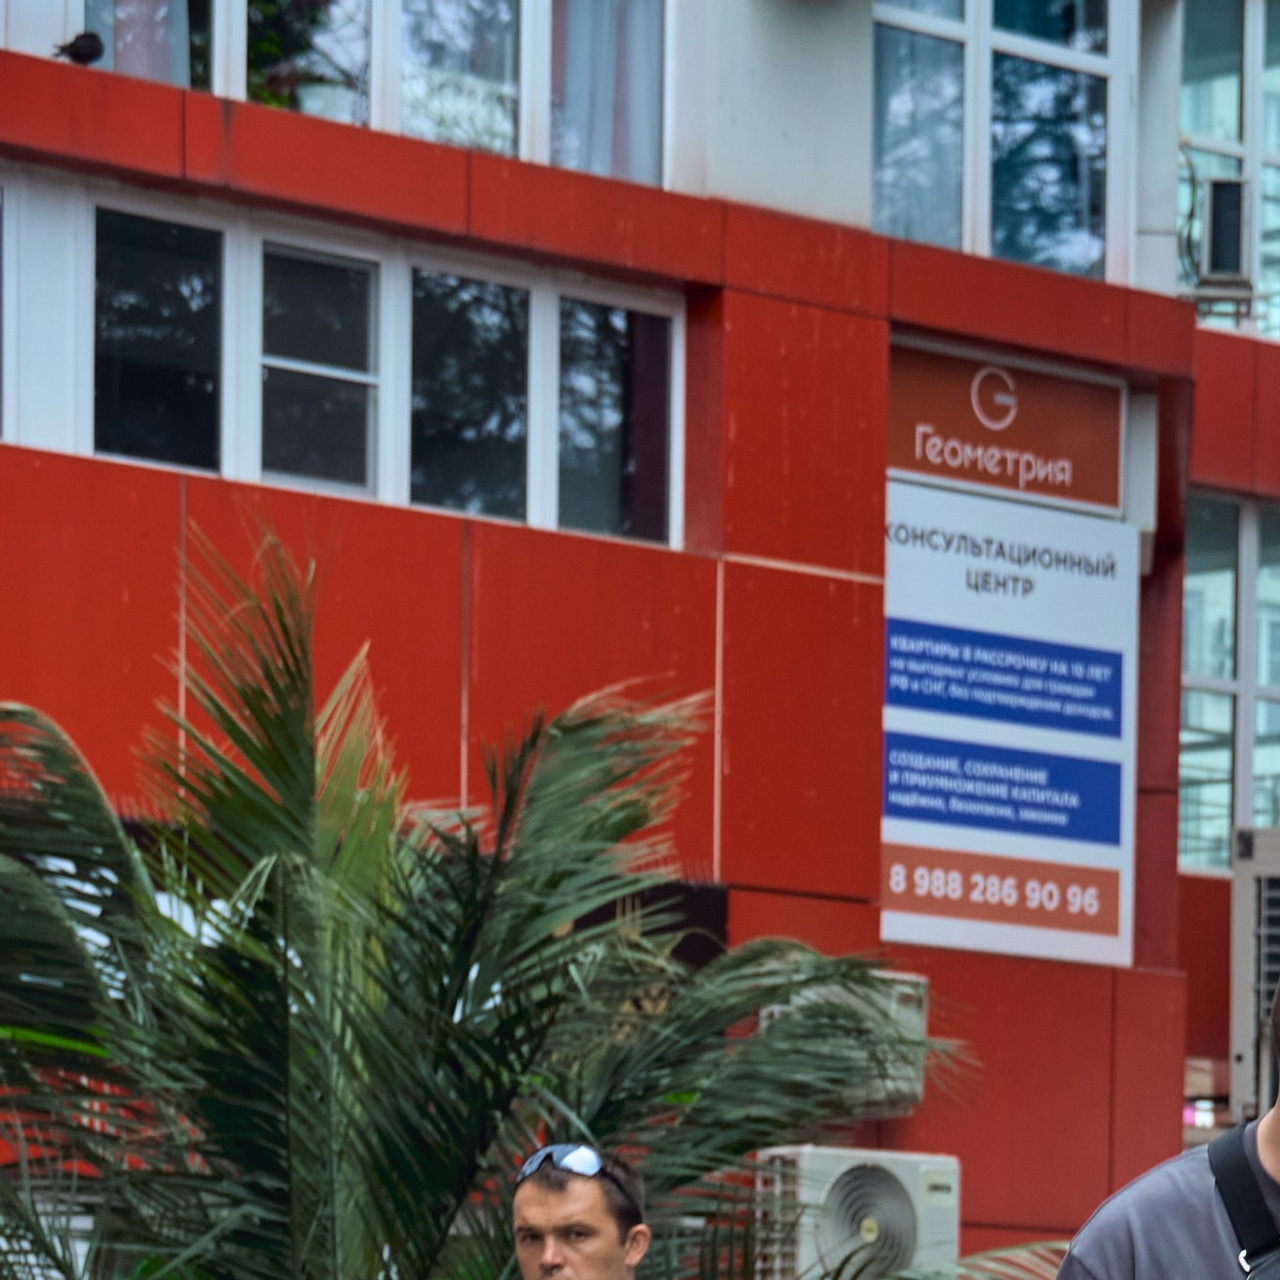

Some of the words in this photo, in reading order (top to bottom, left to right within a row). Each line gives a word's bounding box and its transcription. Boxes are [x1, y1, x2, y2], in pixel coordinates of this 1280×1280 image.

[914, 424, 1073, 488] Геометрия
[966, 568, 1034, 597] ЦЕНТР
[889, 864, 906, 893] 8
[914, 867, 963, 900] 988
[970, 873, 1018, 906] 286
[1025, 880, 1060, 911] 90
[1067, 885, 1100, 916] 96
